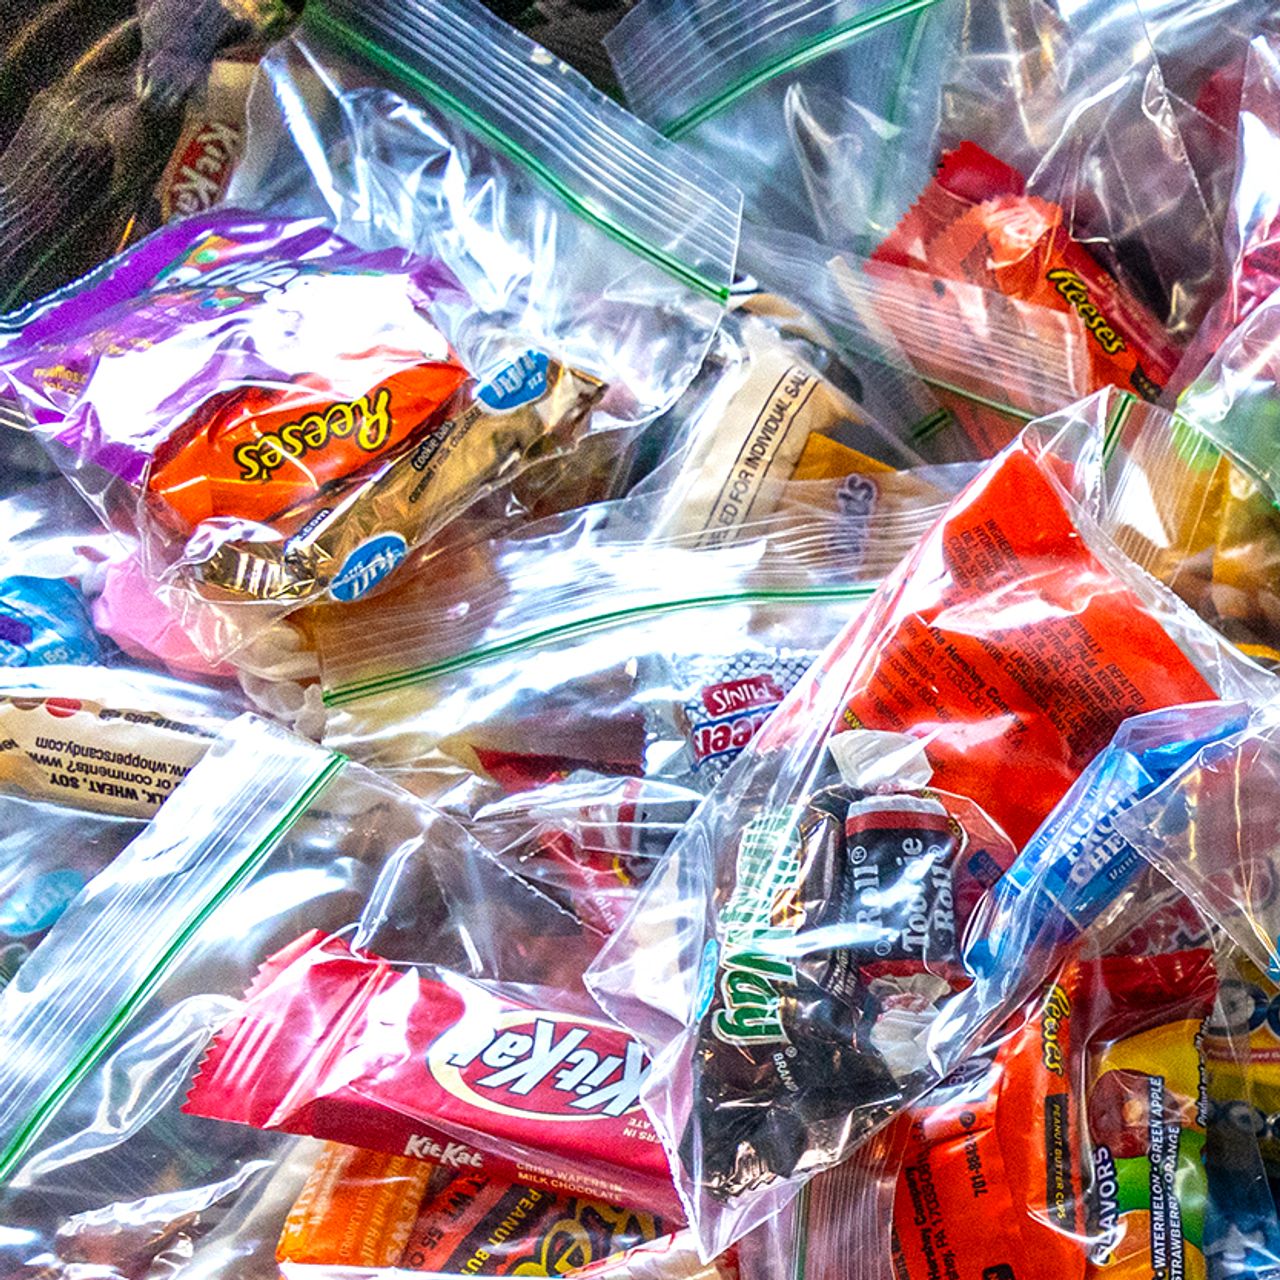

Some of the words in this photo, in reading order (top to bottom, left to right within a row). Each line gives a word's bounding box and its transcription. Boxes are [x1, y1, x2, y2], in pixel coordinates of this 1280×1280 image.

[240, 390, 391, 483] Reese's
[723, 453, 744, 484] FOR
[736, 393, 777, 458] INDIVIDUAL
[944, 643, 988, 689] Hershey
[66, 758, 151, 785] comments?
[1149, 1076, 1164, 1116] APPLE
[402, 1131, 484, 1169] KitKat
[1150, 1118, 1164, 1164] GREEN
[1164, 1125, 1181, 1188] ORANGE
[1151, 1172, 1167, 1269] WATERMELON
